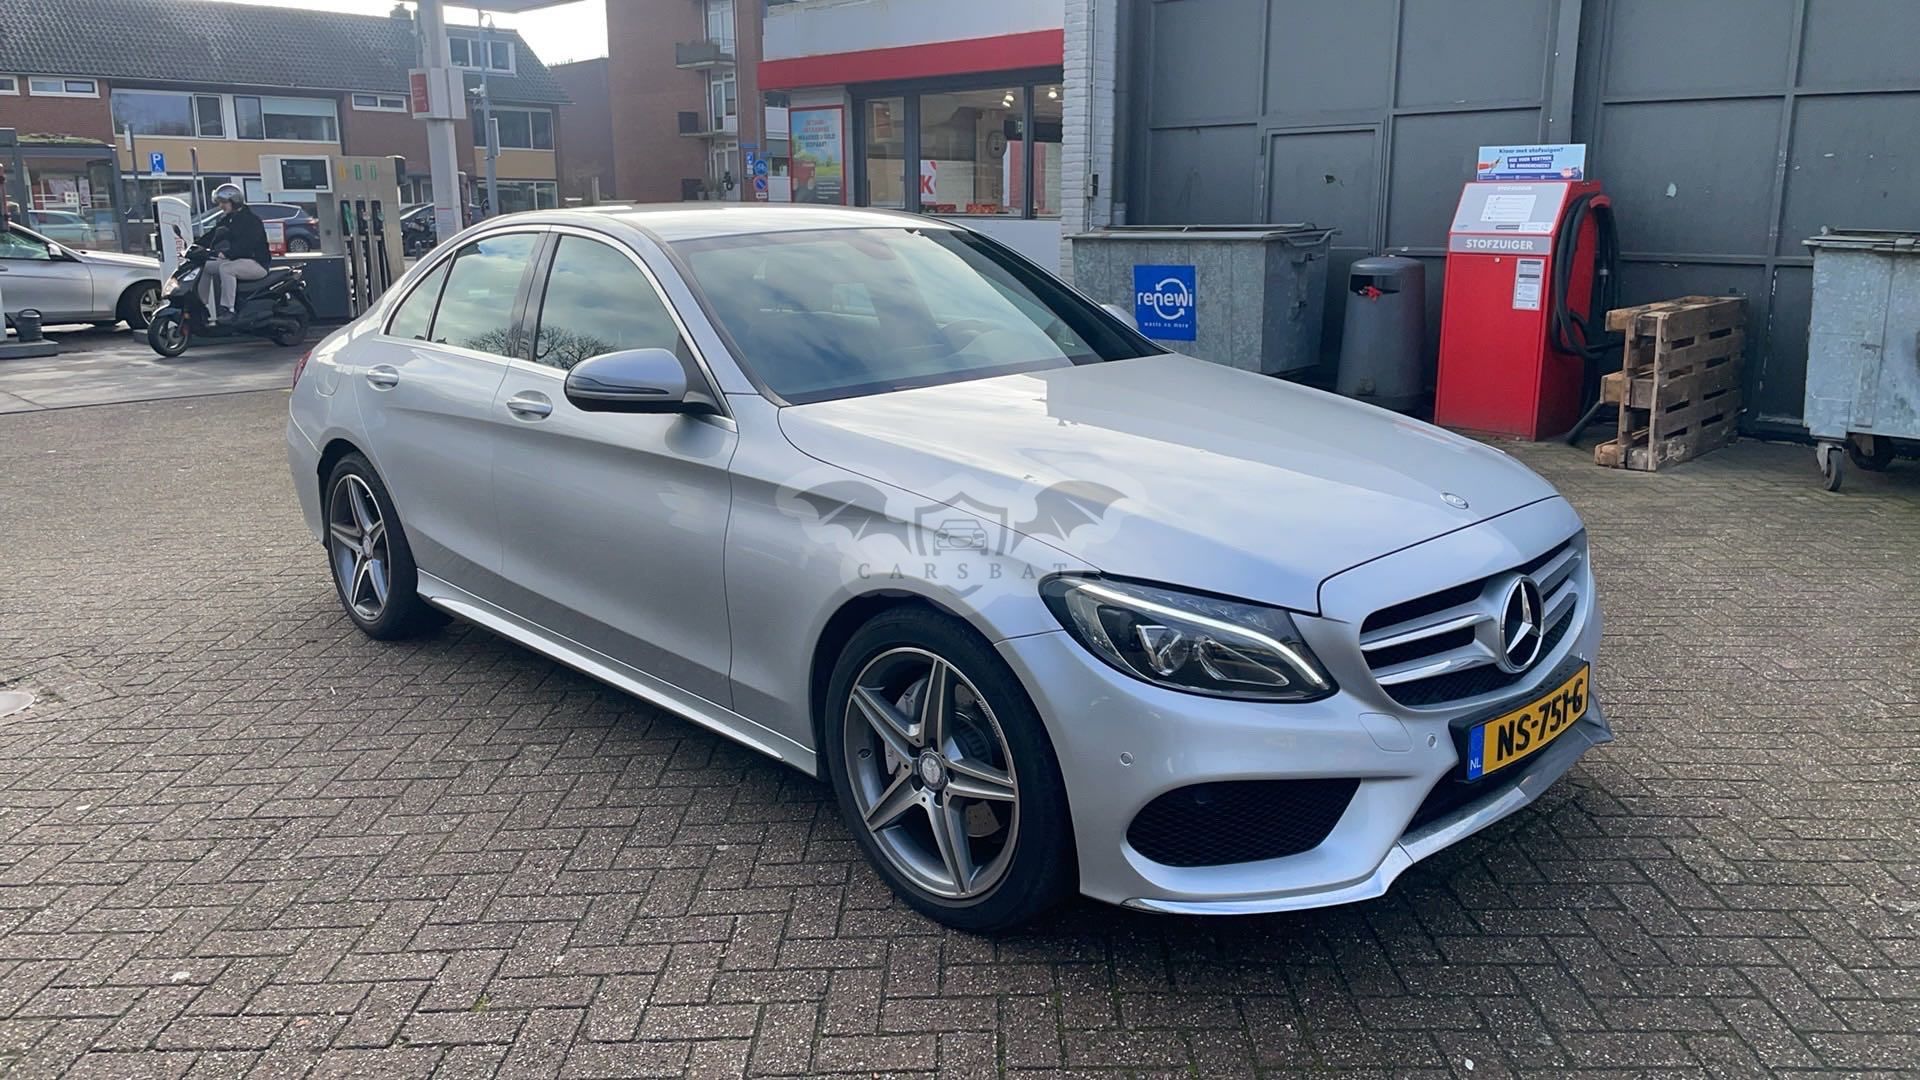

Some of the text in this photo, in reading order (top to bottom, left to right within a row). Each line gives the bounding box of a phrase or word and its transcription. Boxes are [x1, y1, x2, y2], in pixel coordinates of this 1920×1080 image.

[153, 153, 161, 164] P
[920, 175, 934, 194] K
[1466, 239, 1533, 250] STOFZUIGER
[1137, 289, 1193, 307] renewi
[1470, 757, 1482, 770] NL
